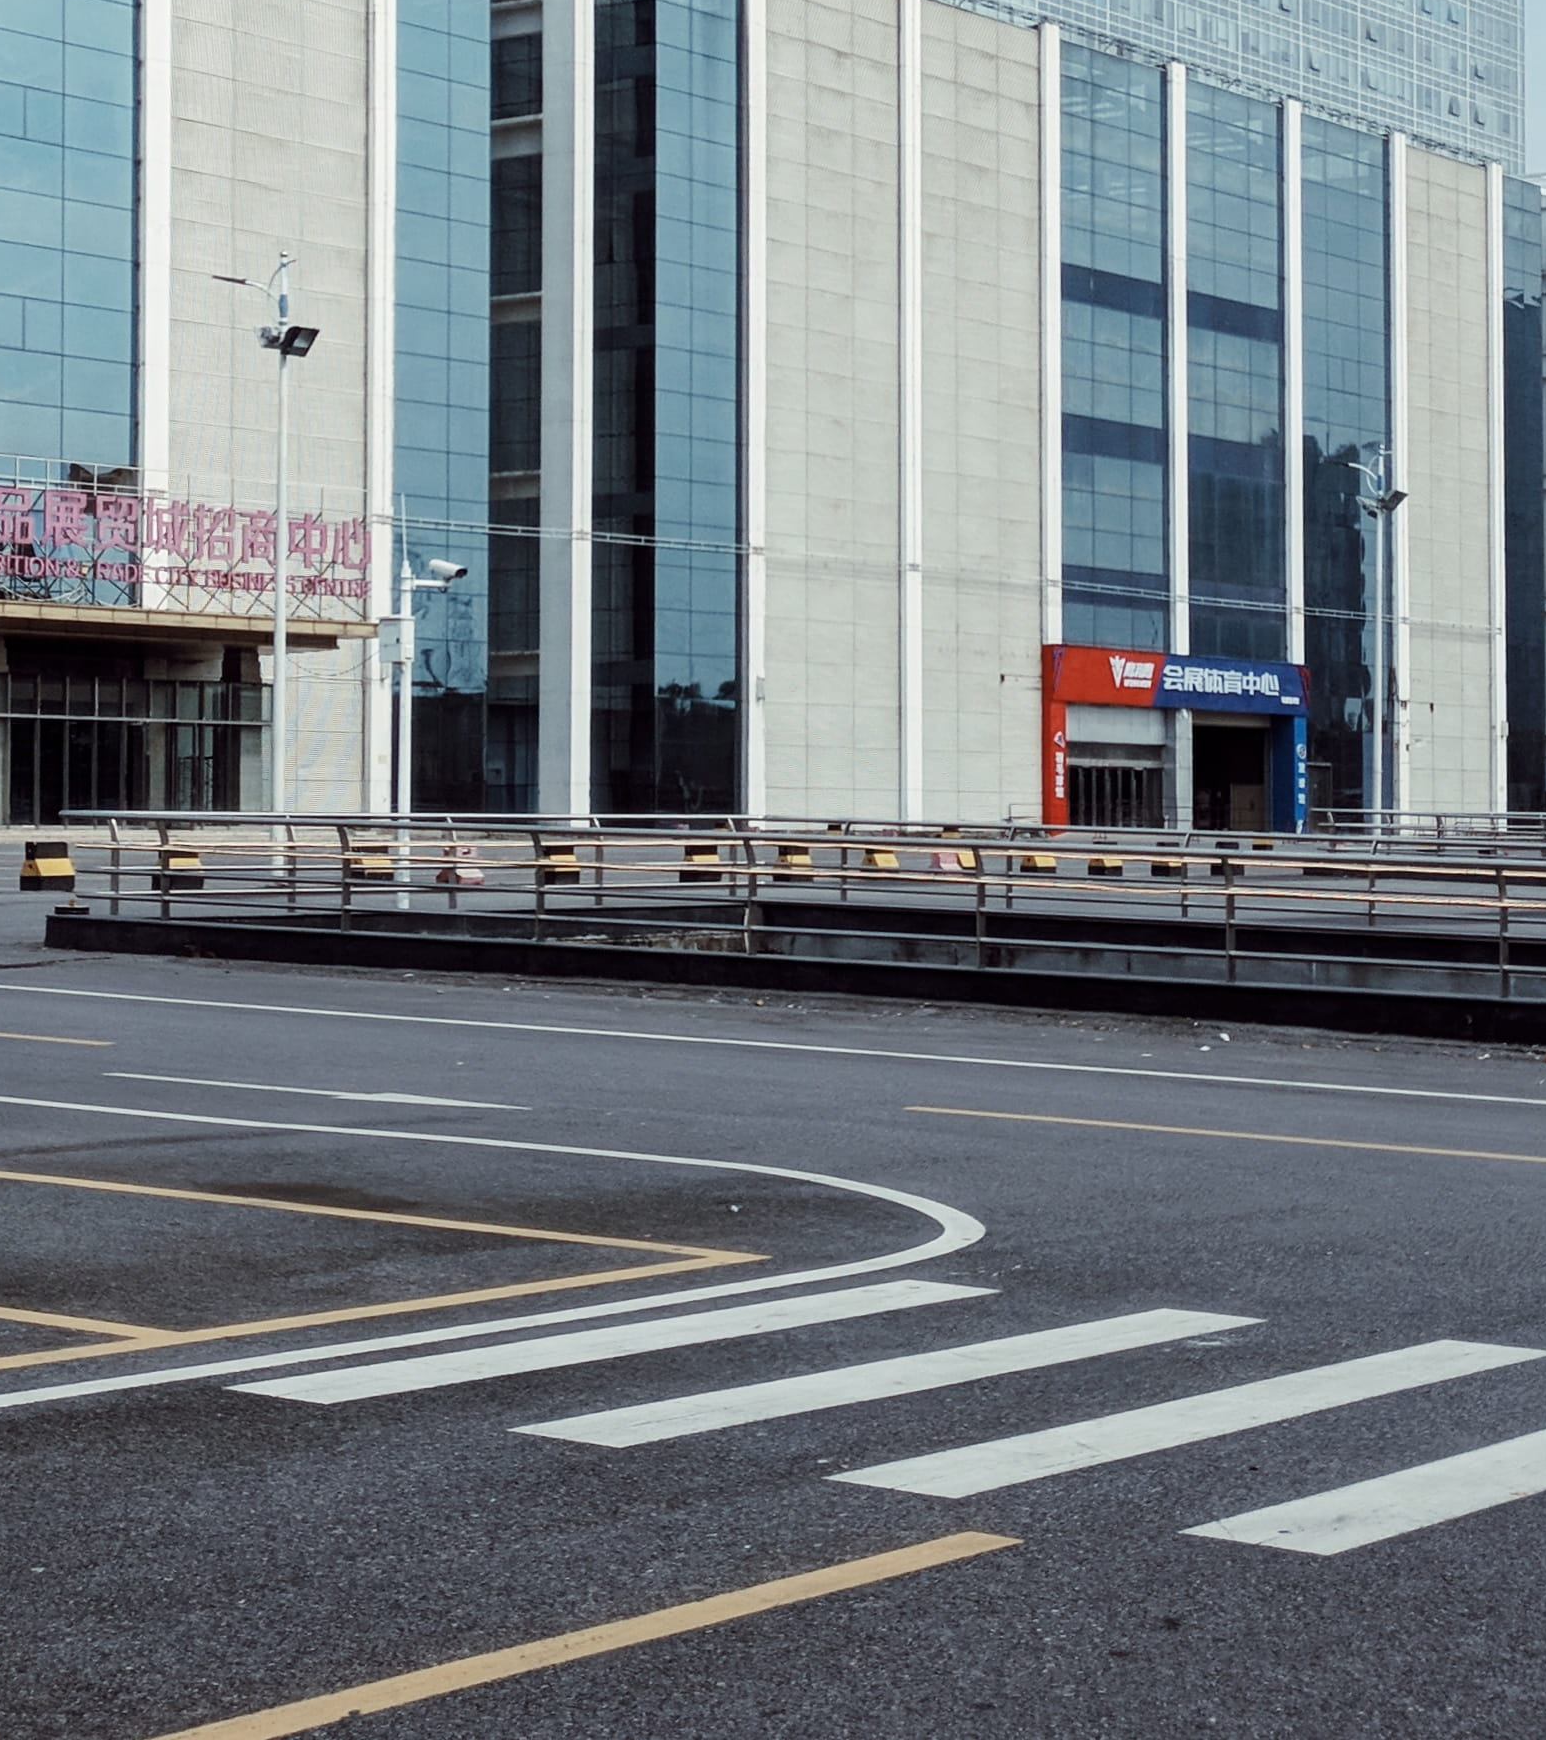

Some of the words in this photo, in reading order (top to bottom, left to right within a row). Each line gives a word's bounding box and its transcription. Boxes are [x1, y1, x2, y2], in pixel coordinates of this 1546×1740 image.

[66, 560, 82, 579] &
[1162, 664, 1280, 697] 会展体育中心
